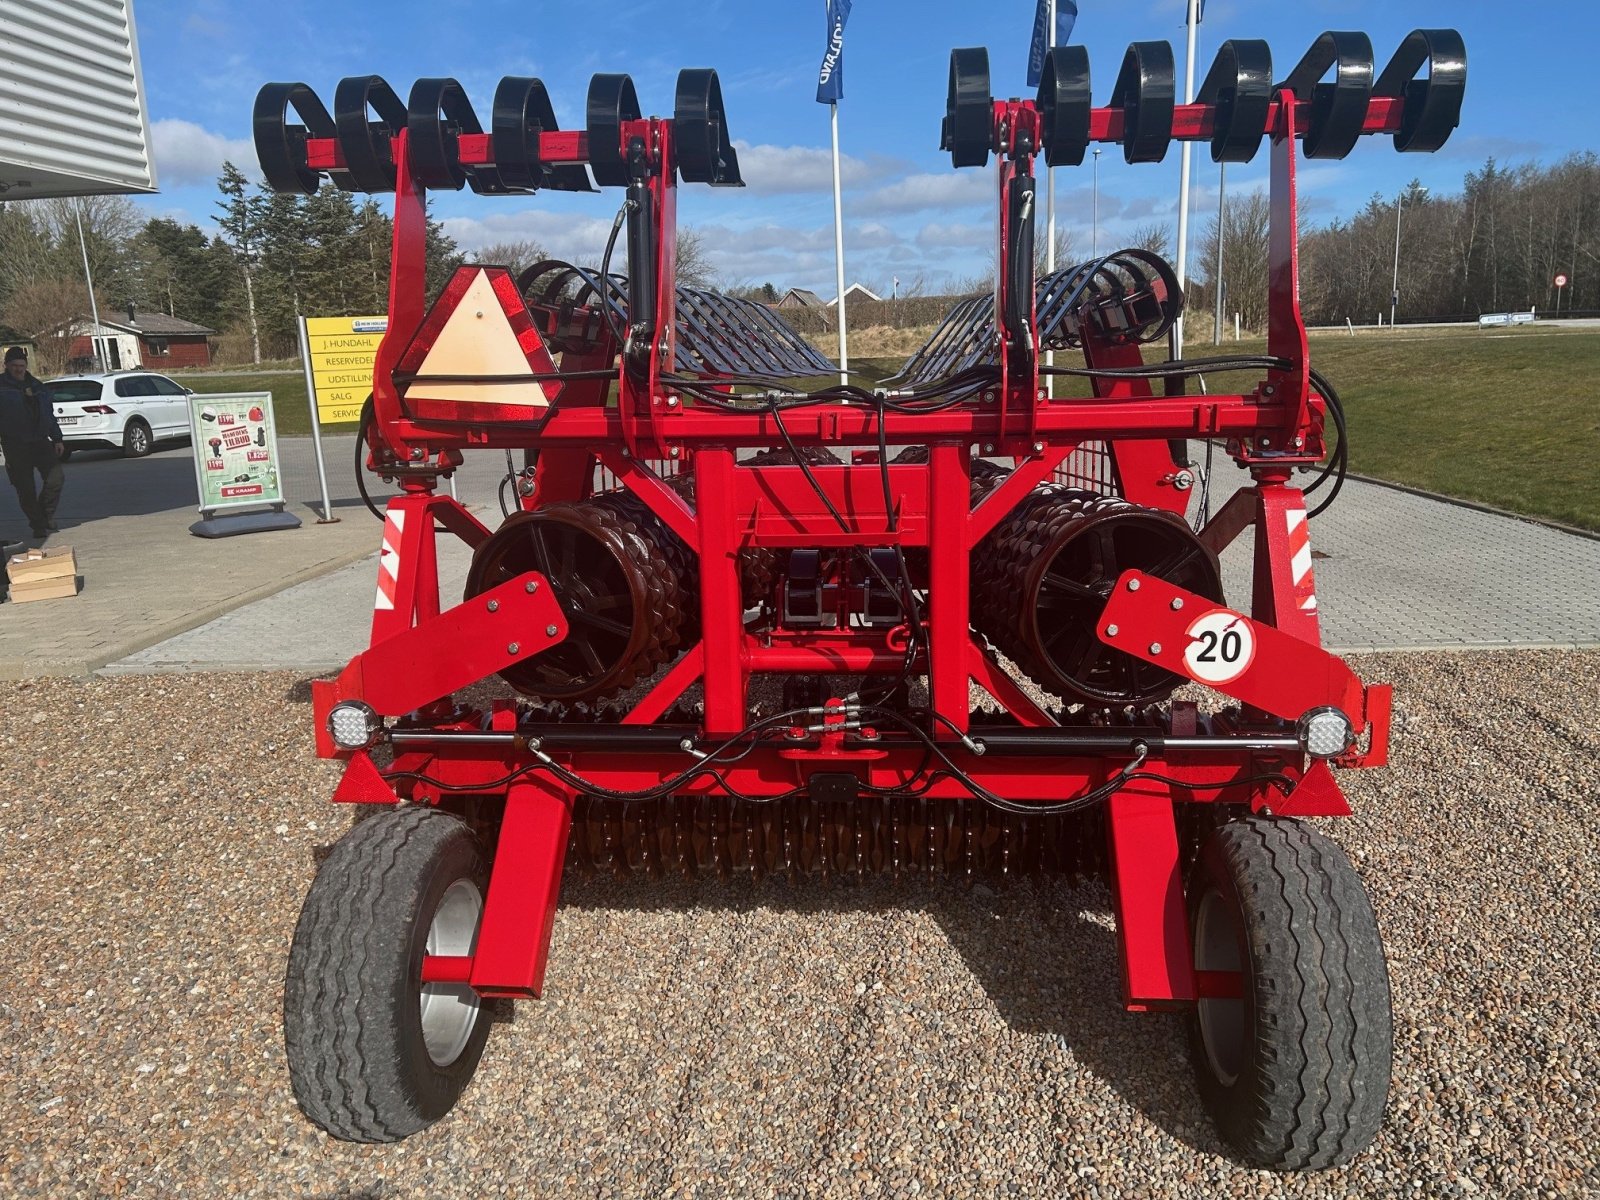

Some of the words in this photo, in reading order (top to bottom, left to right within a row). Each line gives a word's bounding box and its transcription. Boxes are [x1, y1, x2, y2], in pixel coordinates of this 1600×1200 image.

[323, 341, 329, 350] J.
[329, 339, 374, 348] HUNDAHL
[326, 356, 375, 366] RESERVEDEL
[328, 374, 374, 384] UDSTILLIN
[330, 393, 352, 401] SALG
[332, 409, 360, 418] SERVIC
[224, 435, 251, 447] TILBUD
[1196, 630, 1242, 663] 20
